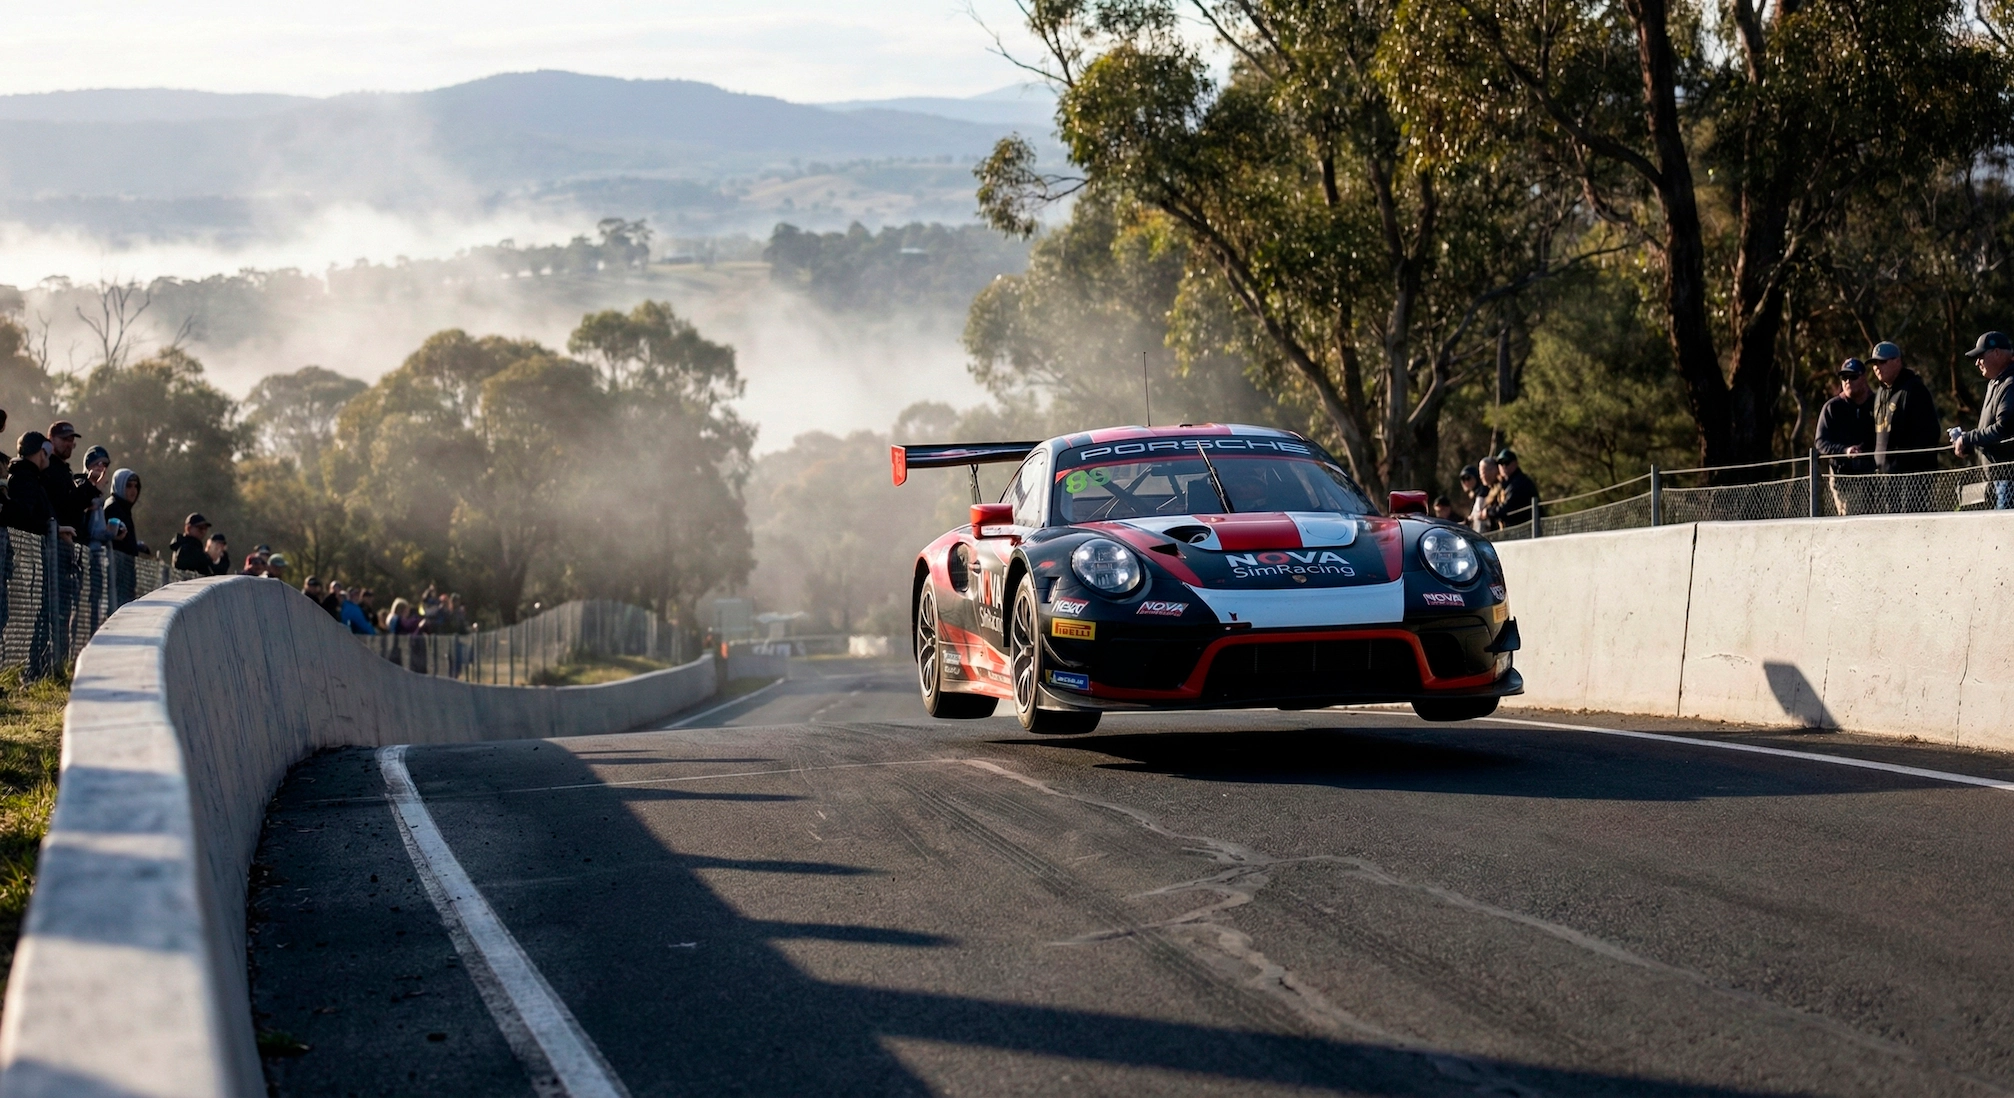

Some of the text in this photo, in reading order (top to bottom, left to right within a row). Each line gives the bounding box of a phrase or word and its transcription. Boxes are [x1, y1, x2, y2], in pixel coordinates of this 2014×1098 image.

[1081, 440, 1310, 460] PORSCHE
[1066, 466, 1112, 494] 89
[1225, 551, 1350, 567] NOVA
[1233, 564, 1356, 578] SimRacing
[978, 570, 1003, 610] NOVA
[1423, 593, 1464, 606] NOVA
[1136, 601, 1185, 615] NOVA
[1055, 621, 1092, 637] PIRELLI
